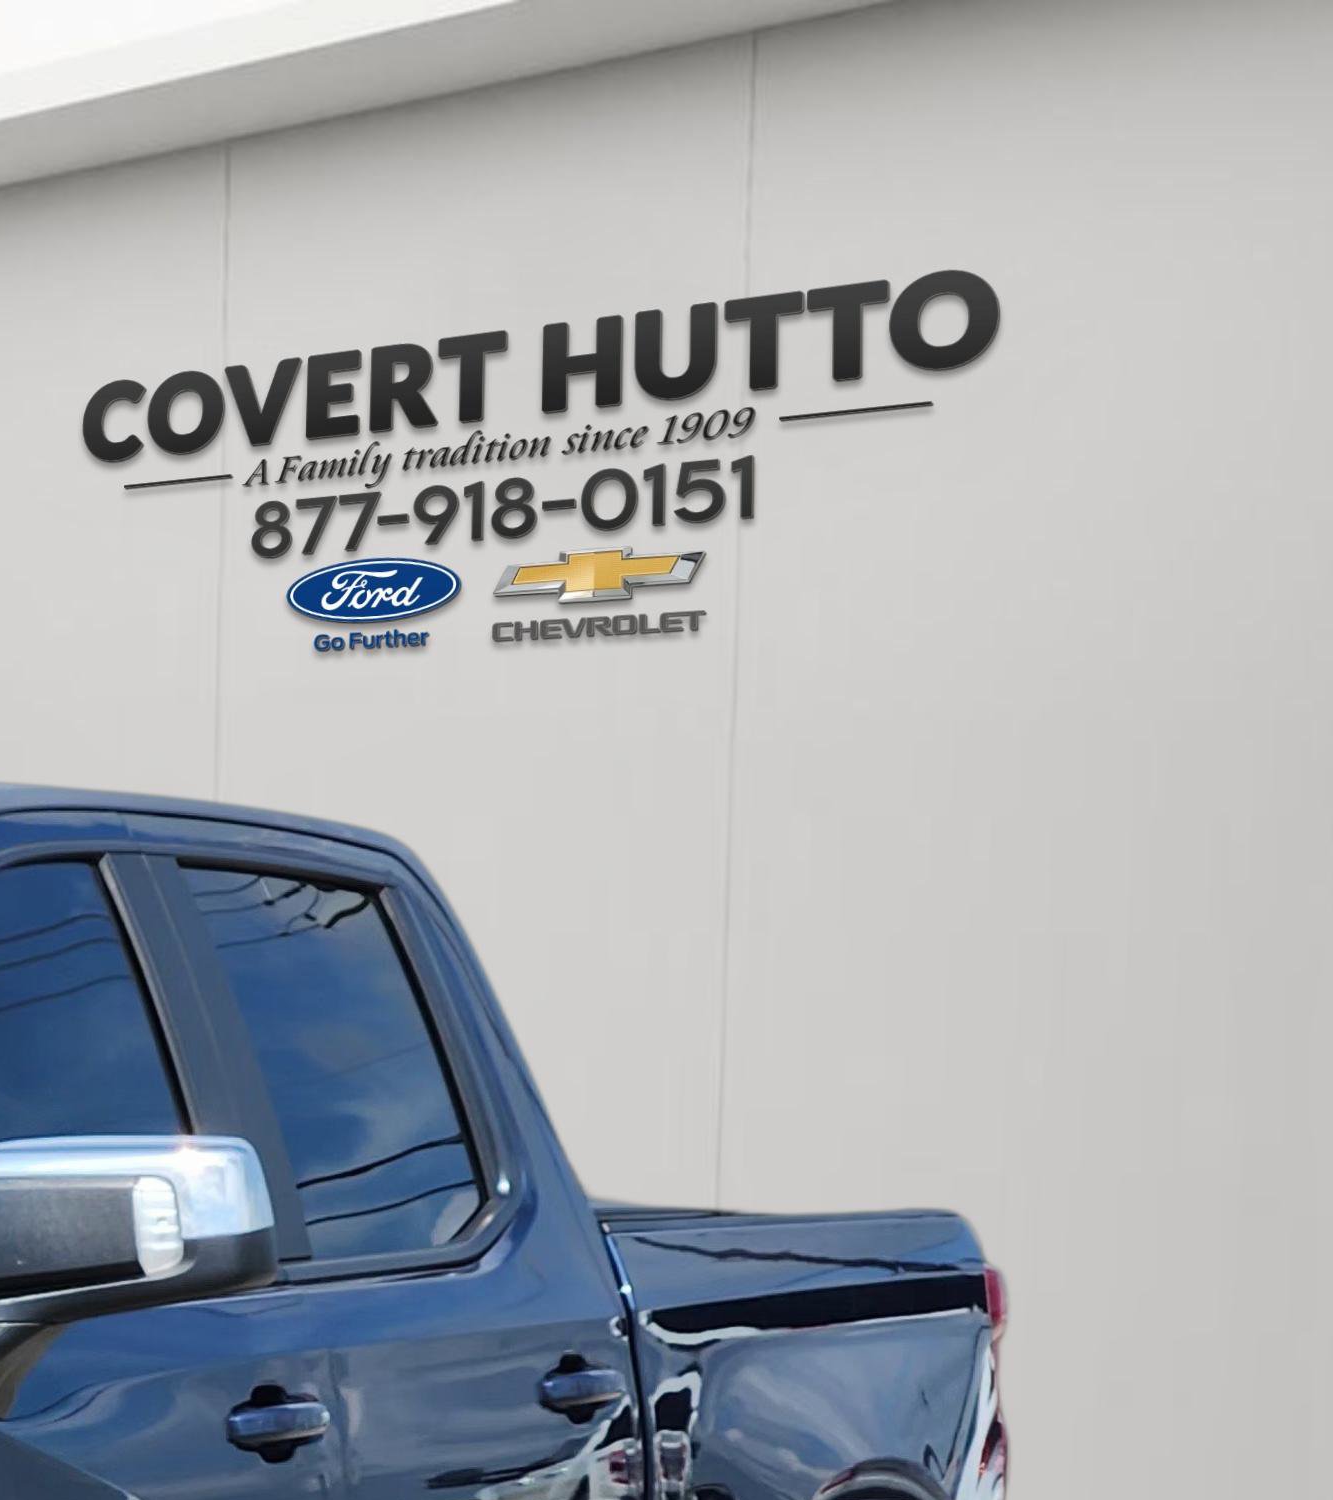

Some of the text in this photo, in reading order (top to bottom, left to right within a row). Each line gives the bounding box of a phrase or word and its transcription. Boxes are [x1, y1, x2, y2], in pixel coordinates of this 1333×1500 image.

[83, 270, 1001, 464] COVERT HUTTO
[242, 406, 756, 489] A Family tradition since 1909
[251, 454, 755, 560] 877-918-0151
[320, 569, 424, 610] Ford
[313, 628, 430, 653] Go Further
[491, 609, 707, 643] CHEVROLET
